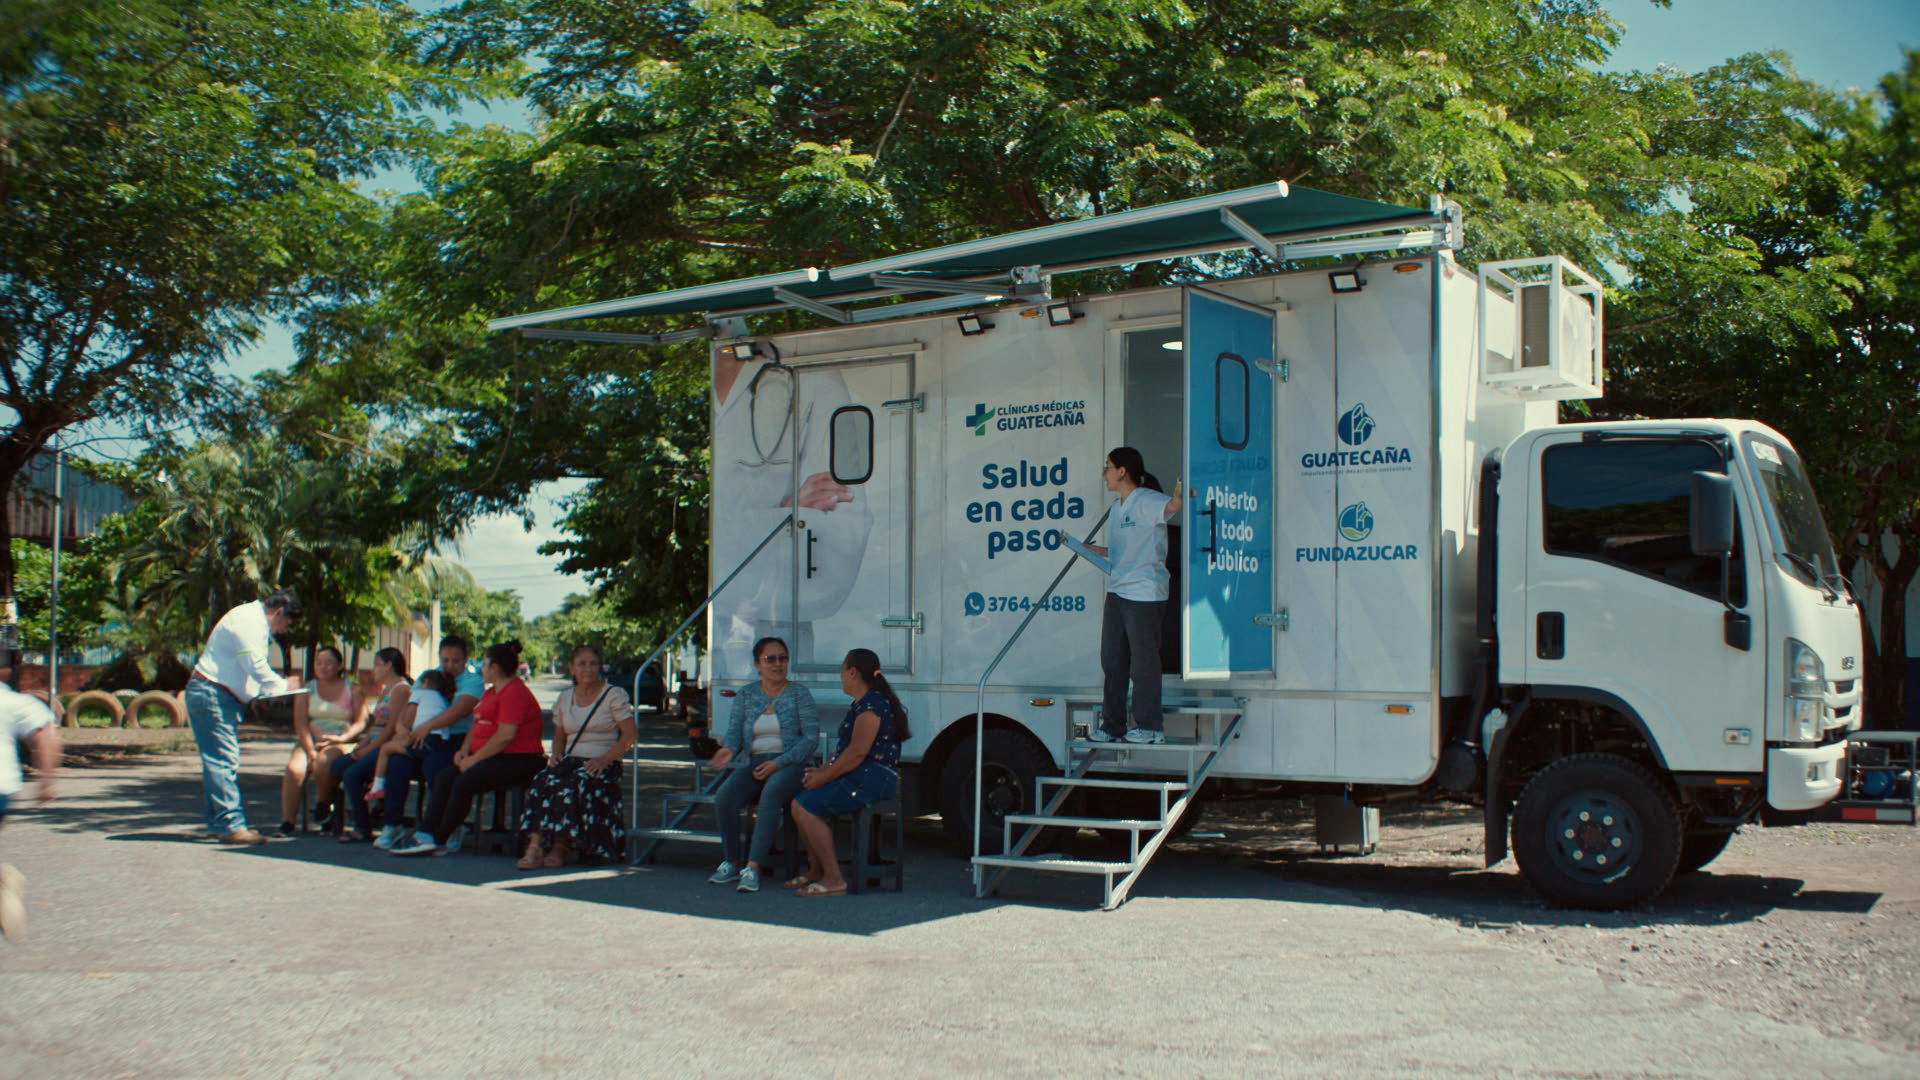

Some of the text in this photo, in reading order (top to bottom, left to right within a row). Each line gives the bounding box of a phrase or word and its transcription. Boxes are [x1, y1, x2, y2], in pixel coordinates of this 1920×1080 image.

[997, 400, 1085, 416] CLÍNICAS MÉDICAS
[996, 410, 1085, 431] GUATECAÑA
[1301, 446, 1412, 468] GUATECAÑA
[982, 457, 1068, 490] Salud
[966, 491, 1084, 523] en cada
[1205, 486, 1258, 512] Abierto
[1221, 519, 1254, 542] todo
[988, 528, 1062, 559] paso
[1296, 544, 1418, 562] FUNDAZUCAR
[988, 596, 1086, 612] 3764-4888
